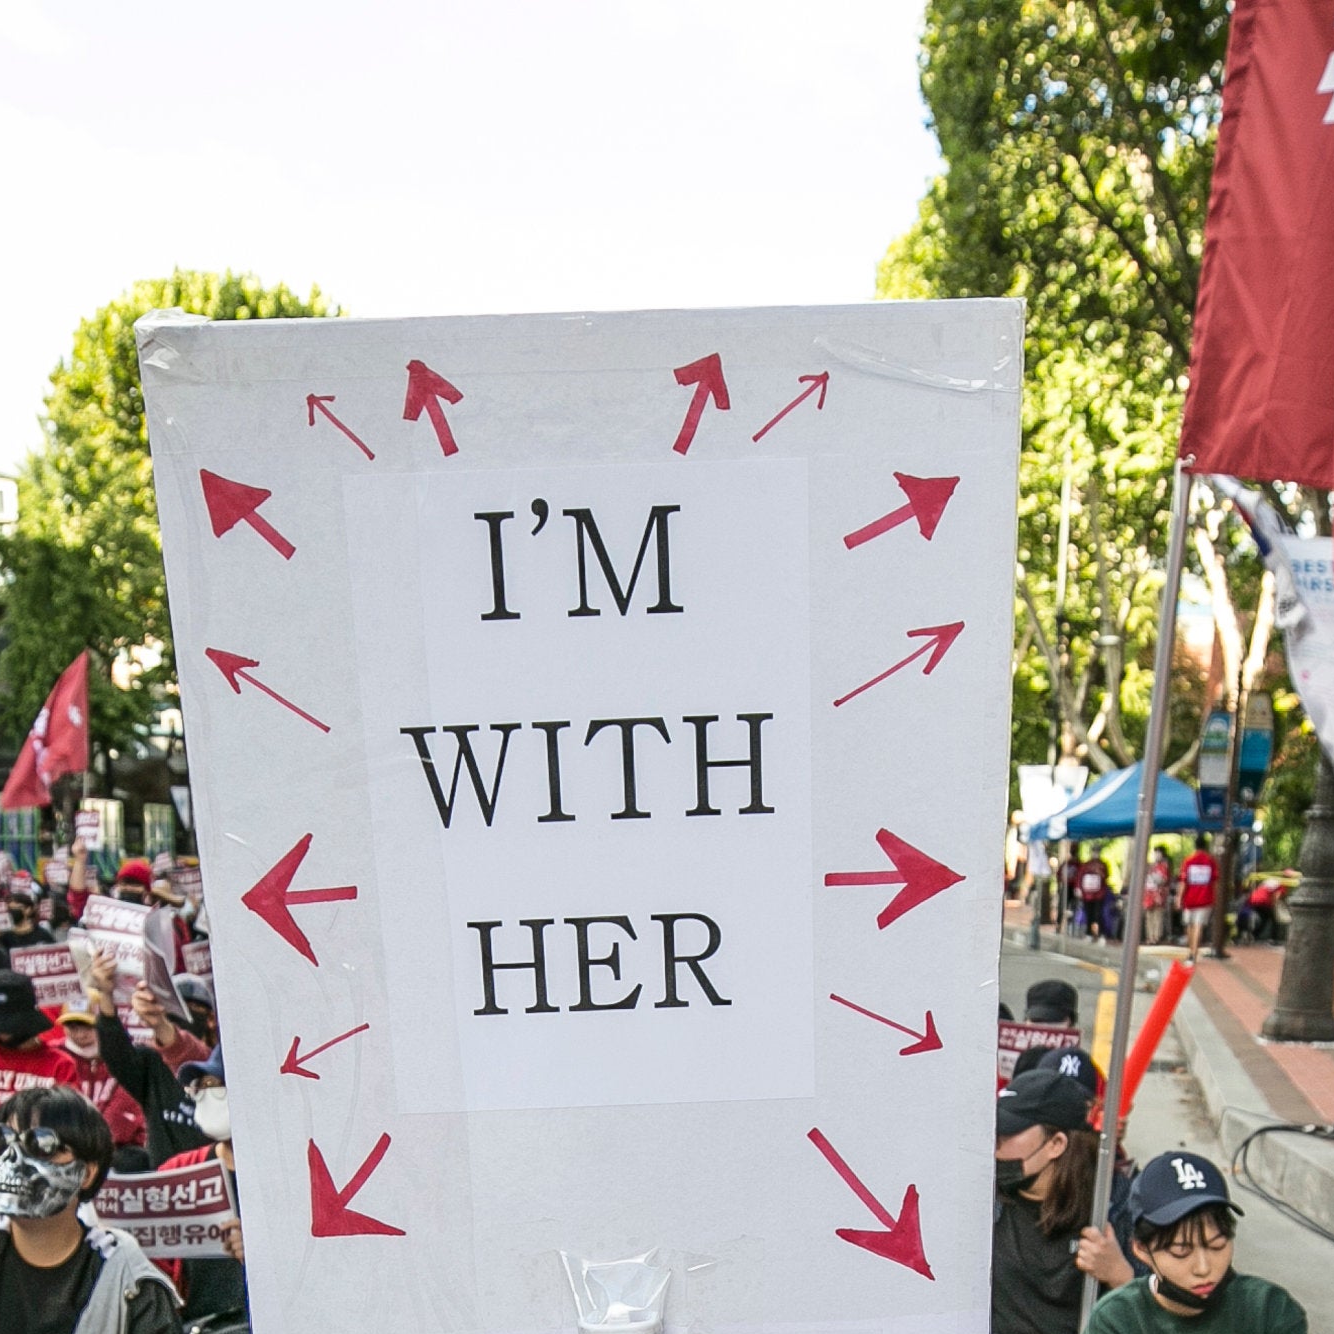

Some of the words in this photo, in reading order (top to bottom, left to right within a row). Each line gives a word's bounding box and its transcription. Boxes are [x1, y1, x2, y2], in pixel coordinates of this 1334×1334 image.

[473, 497, 684, 621] I'M
[399, 712, 775, 829] WITH
[467, 912, 732, 1016] HER
[120, 1176, 223, 1214] 실형선고
[1171, 1158, 1207, 1190] LA
